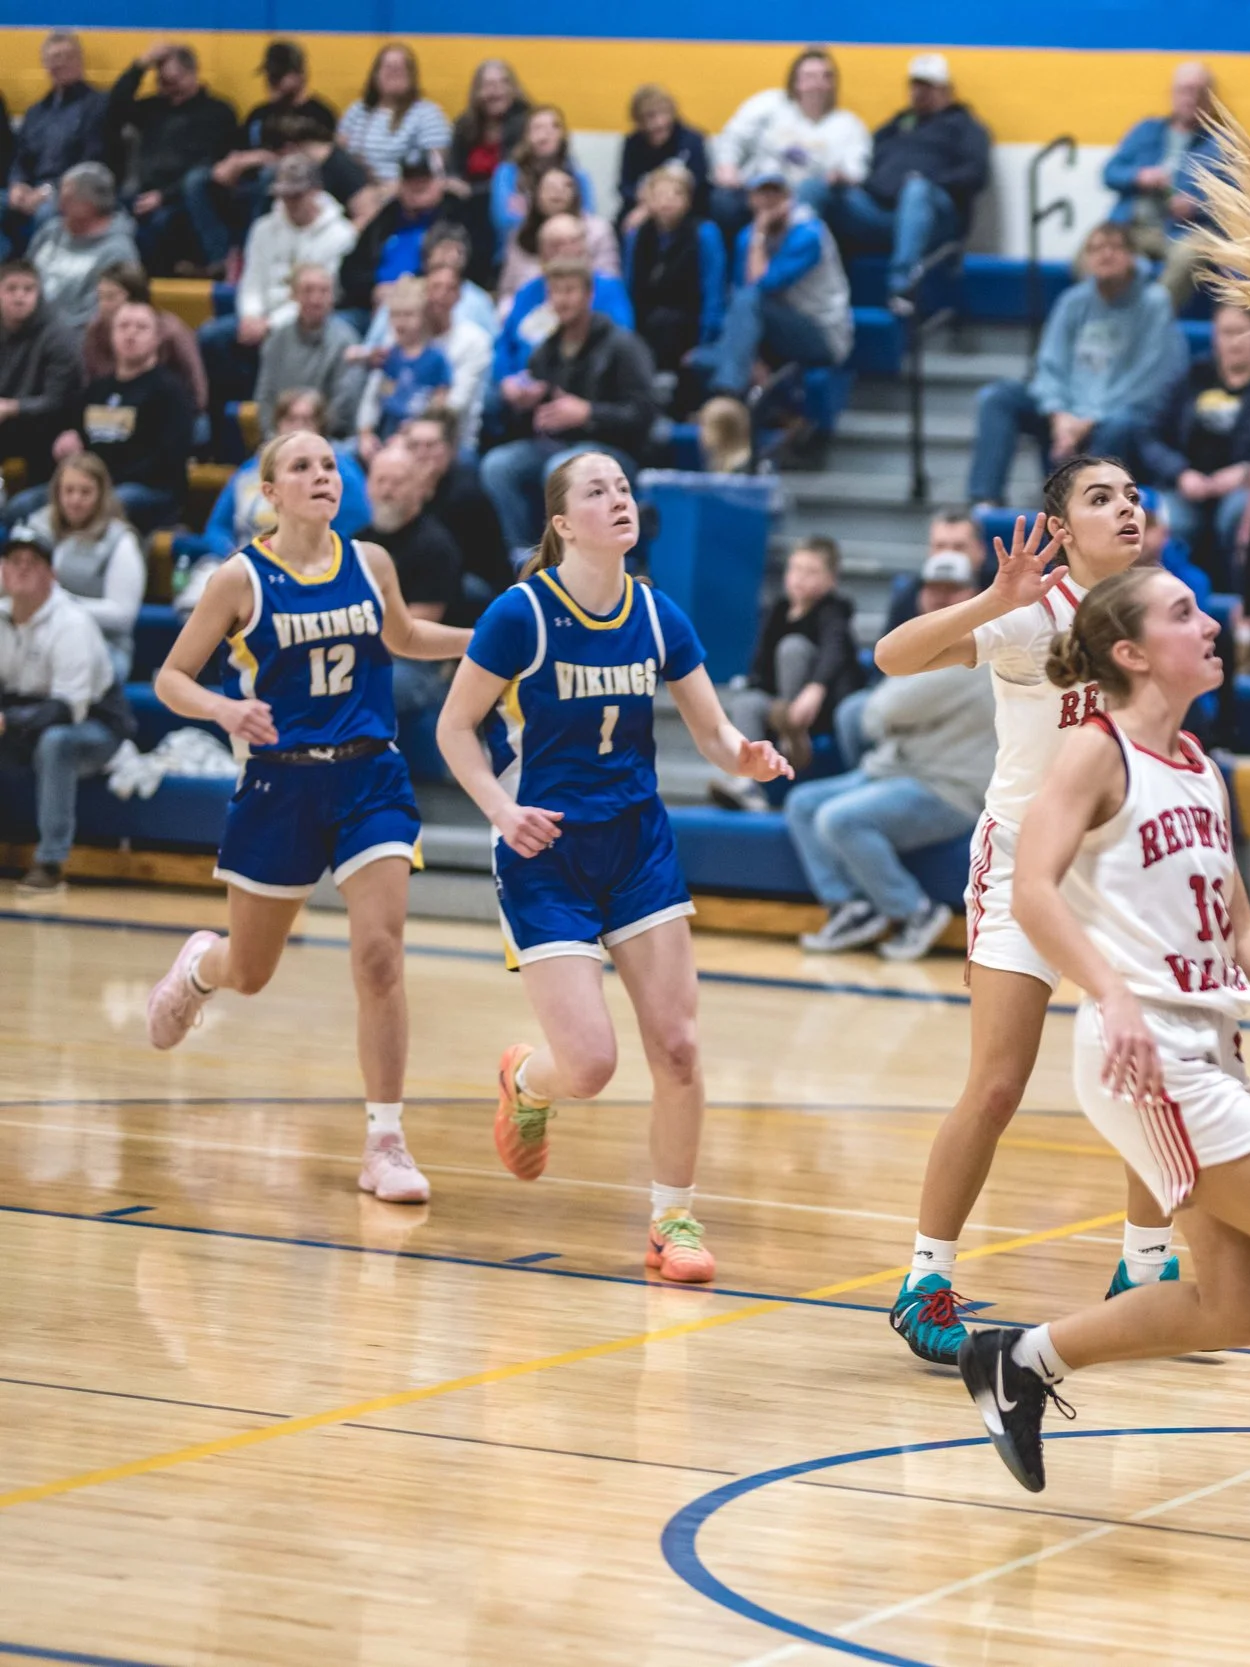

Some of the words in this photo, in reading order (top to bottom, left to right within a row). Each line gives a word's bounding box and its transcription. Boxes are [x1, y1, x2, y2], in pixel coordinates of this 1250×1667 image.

[272, 599, 379, 649] VIKINGS
[309, 643, 356, 696] 12
[554, 657, 657, 701] VIKINGS
[598, 705, 620, 755] 1
